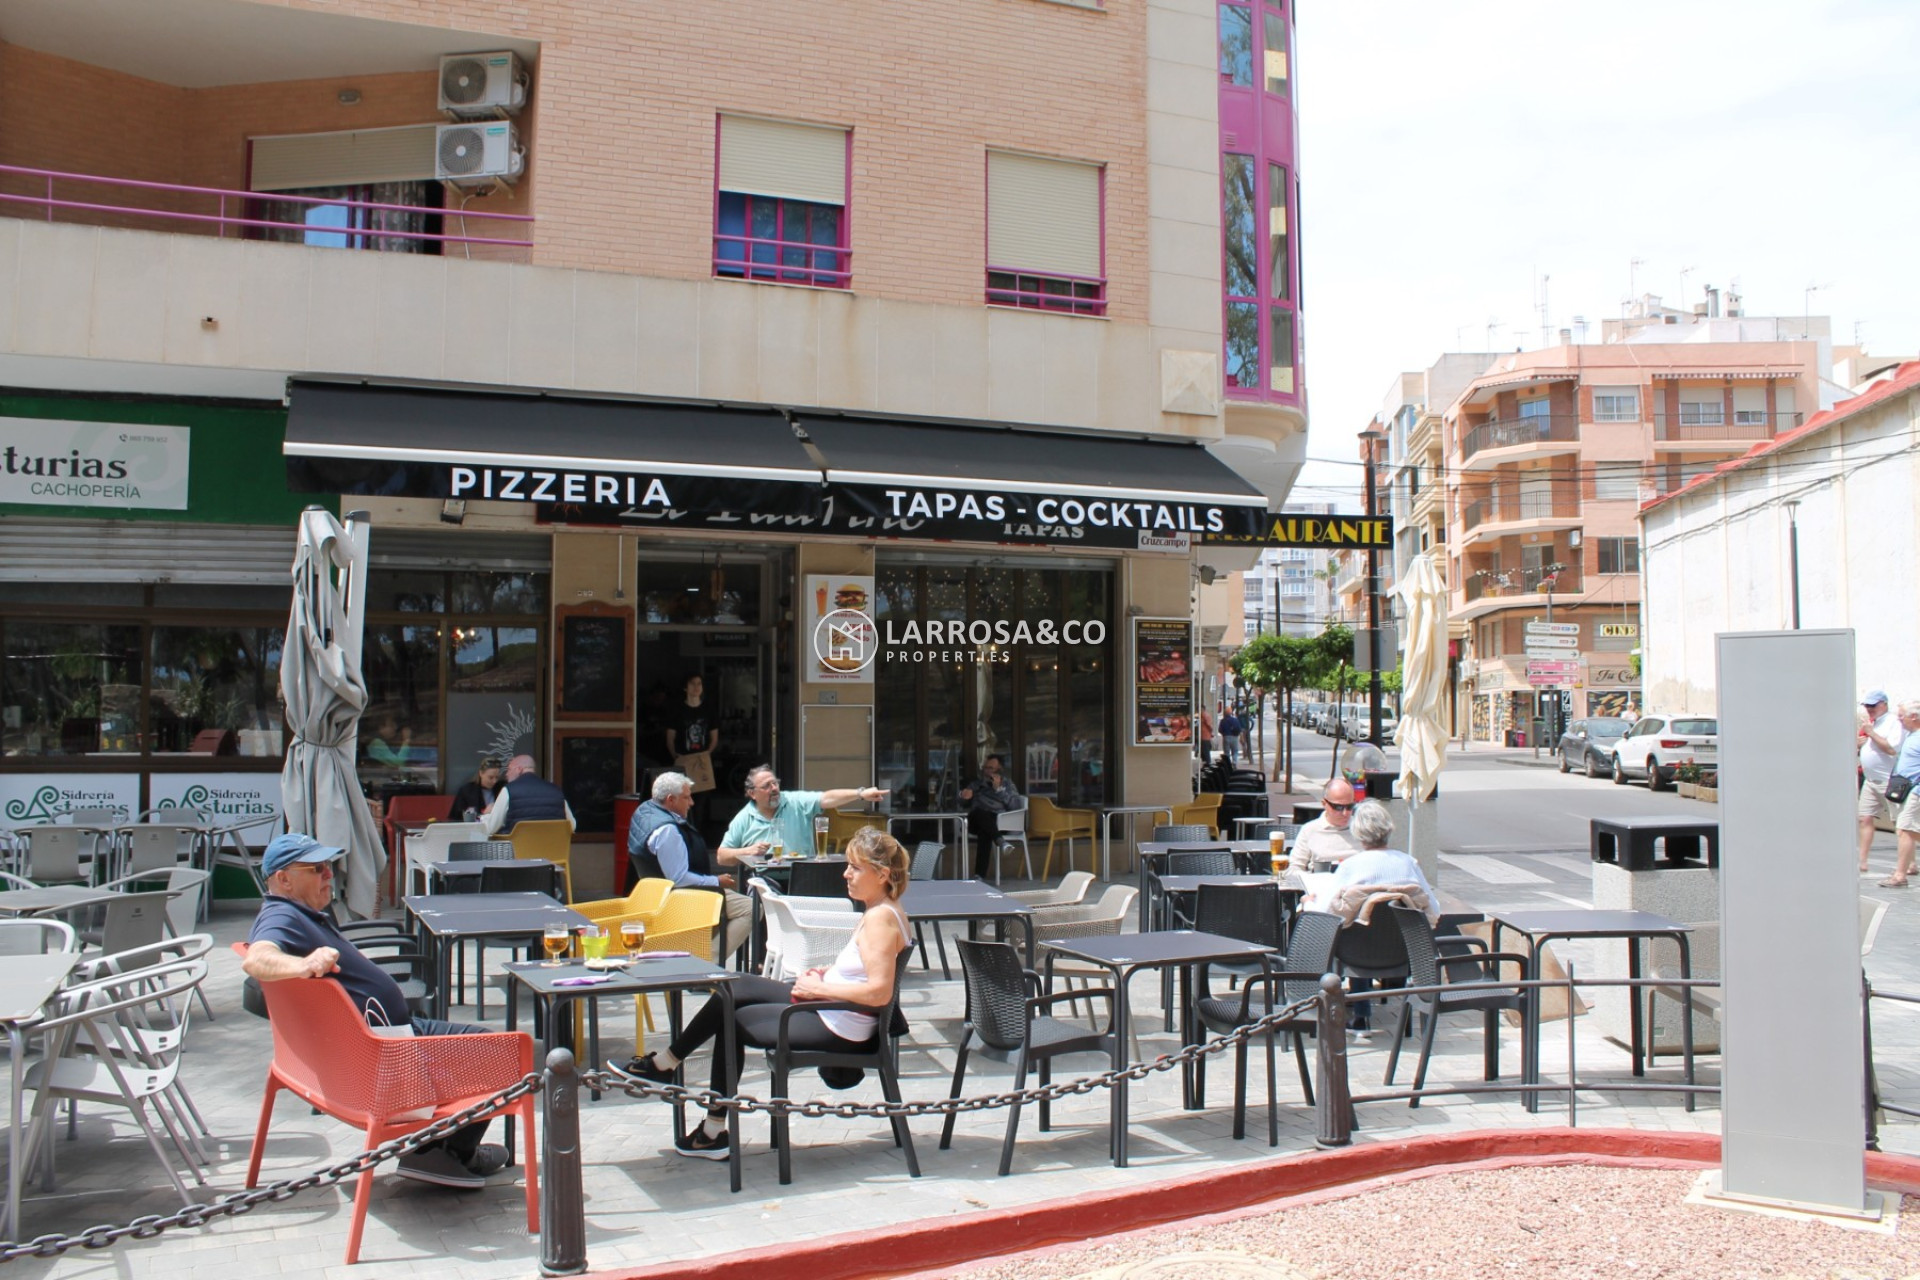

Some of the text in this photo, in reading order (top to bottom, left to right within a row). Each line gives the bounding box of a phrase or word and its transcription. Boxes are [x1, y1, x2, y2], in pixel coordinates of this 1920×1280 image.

[0, 446, 127, 479] turias
[31, 482, 141, 499] CACHOPERÍA
[451, 467, 671, 506] PIZZERIA
[886, 490, 1005, 521] TAPAS
[1036, 498, 1224, 532] COCKTAILS
[1140, 535, 1187, 548] Cruzcampo
